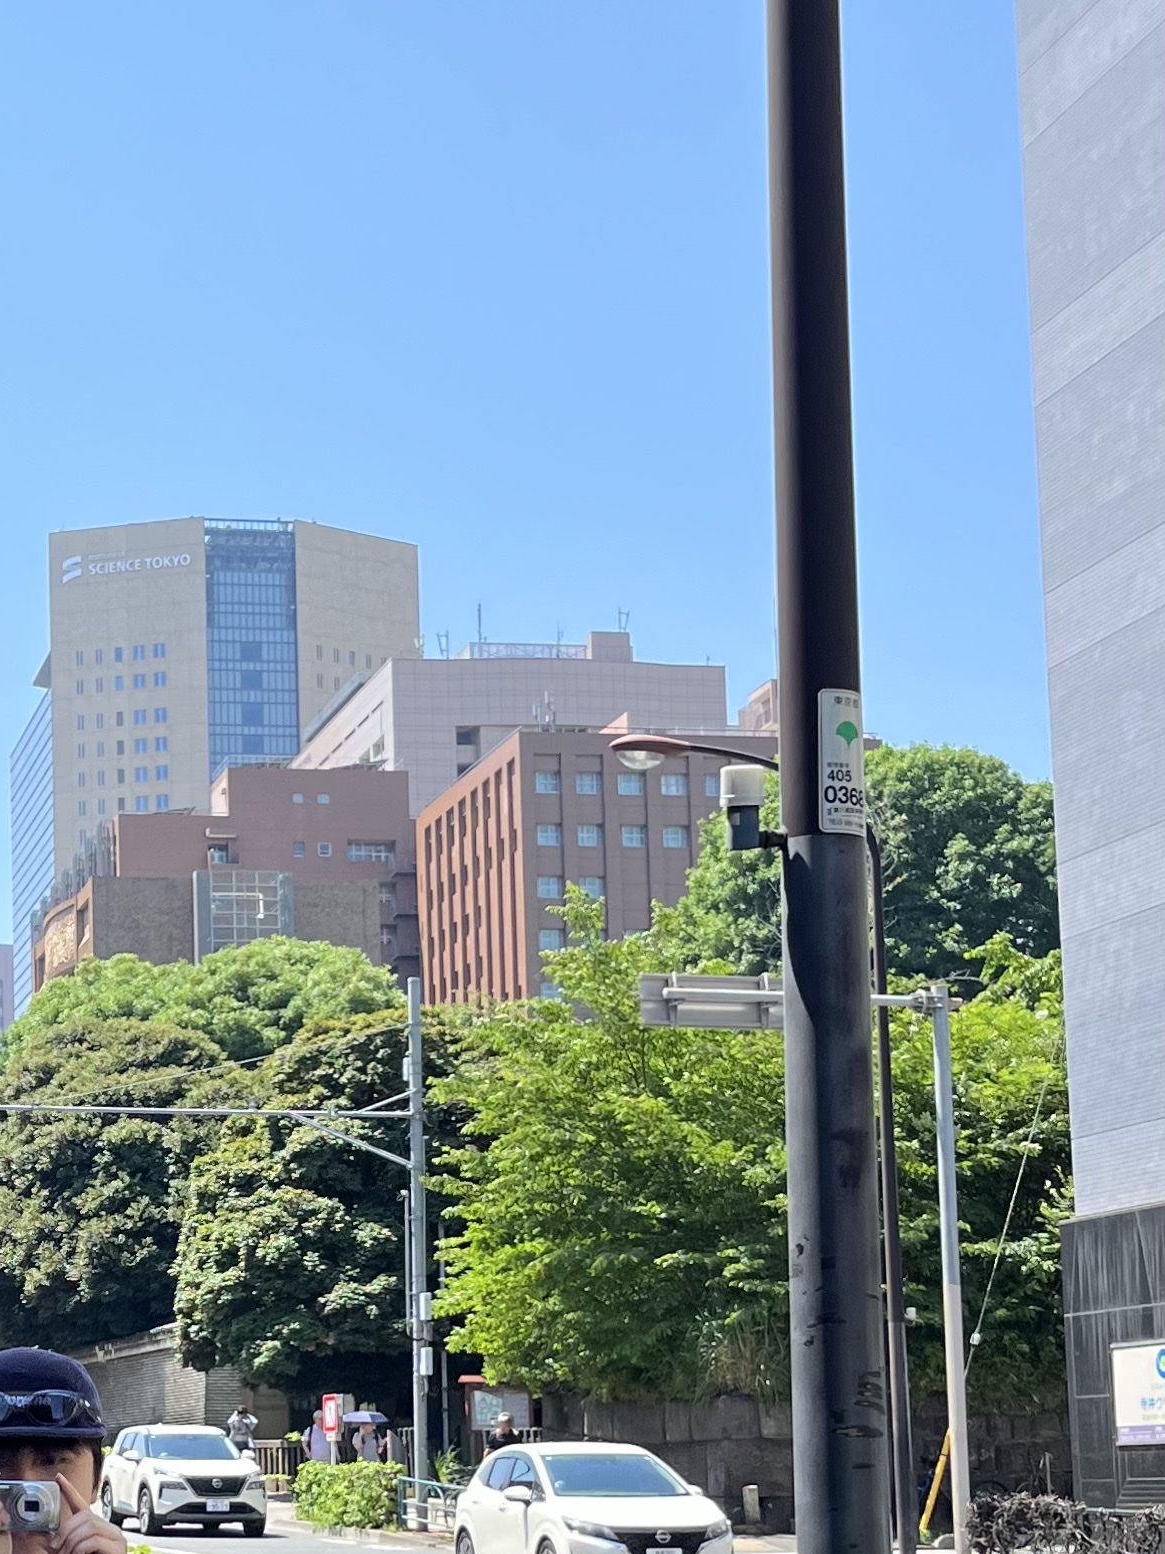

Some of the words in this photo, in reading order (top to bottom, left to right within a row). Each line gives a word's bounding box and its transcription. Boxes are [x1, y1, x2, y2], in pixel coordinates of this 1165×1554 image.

[88, 559, 142, 576] SCIENCE
[145, 553, 191, 570] TOKYO
[827, 769, 852, 783] 405
